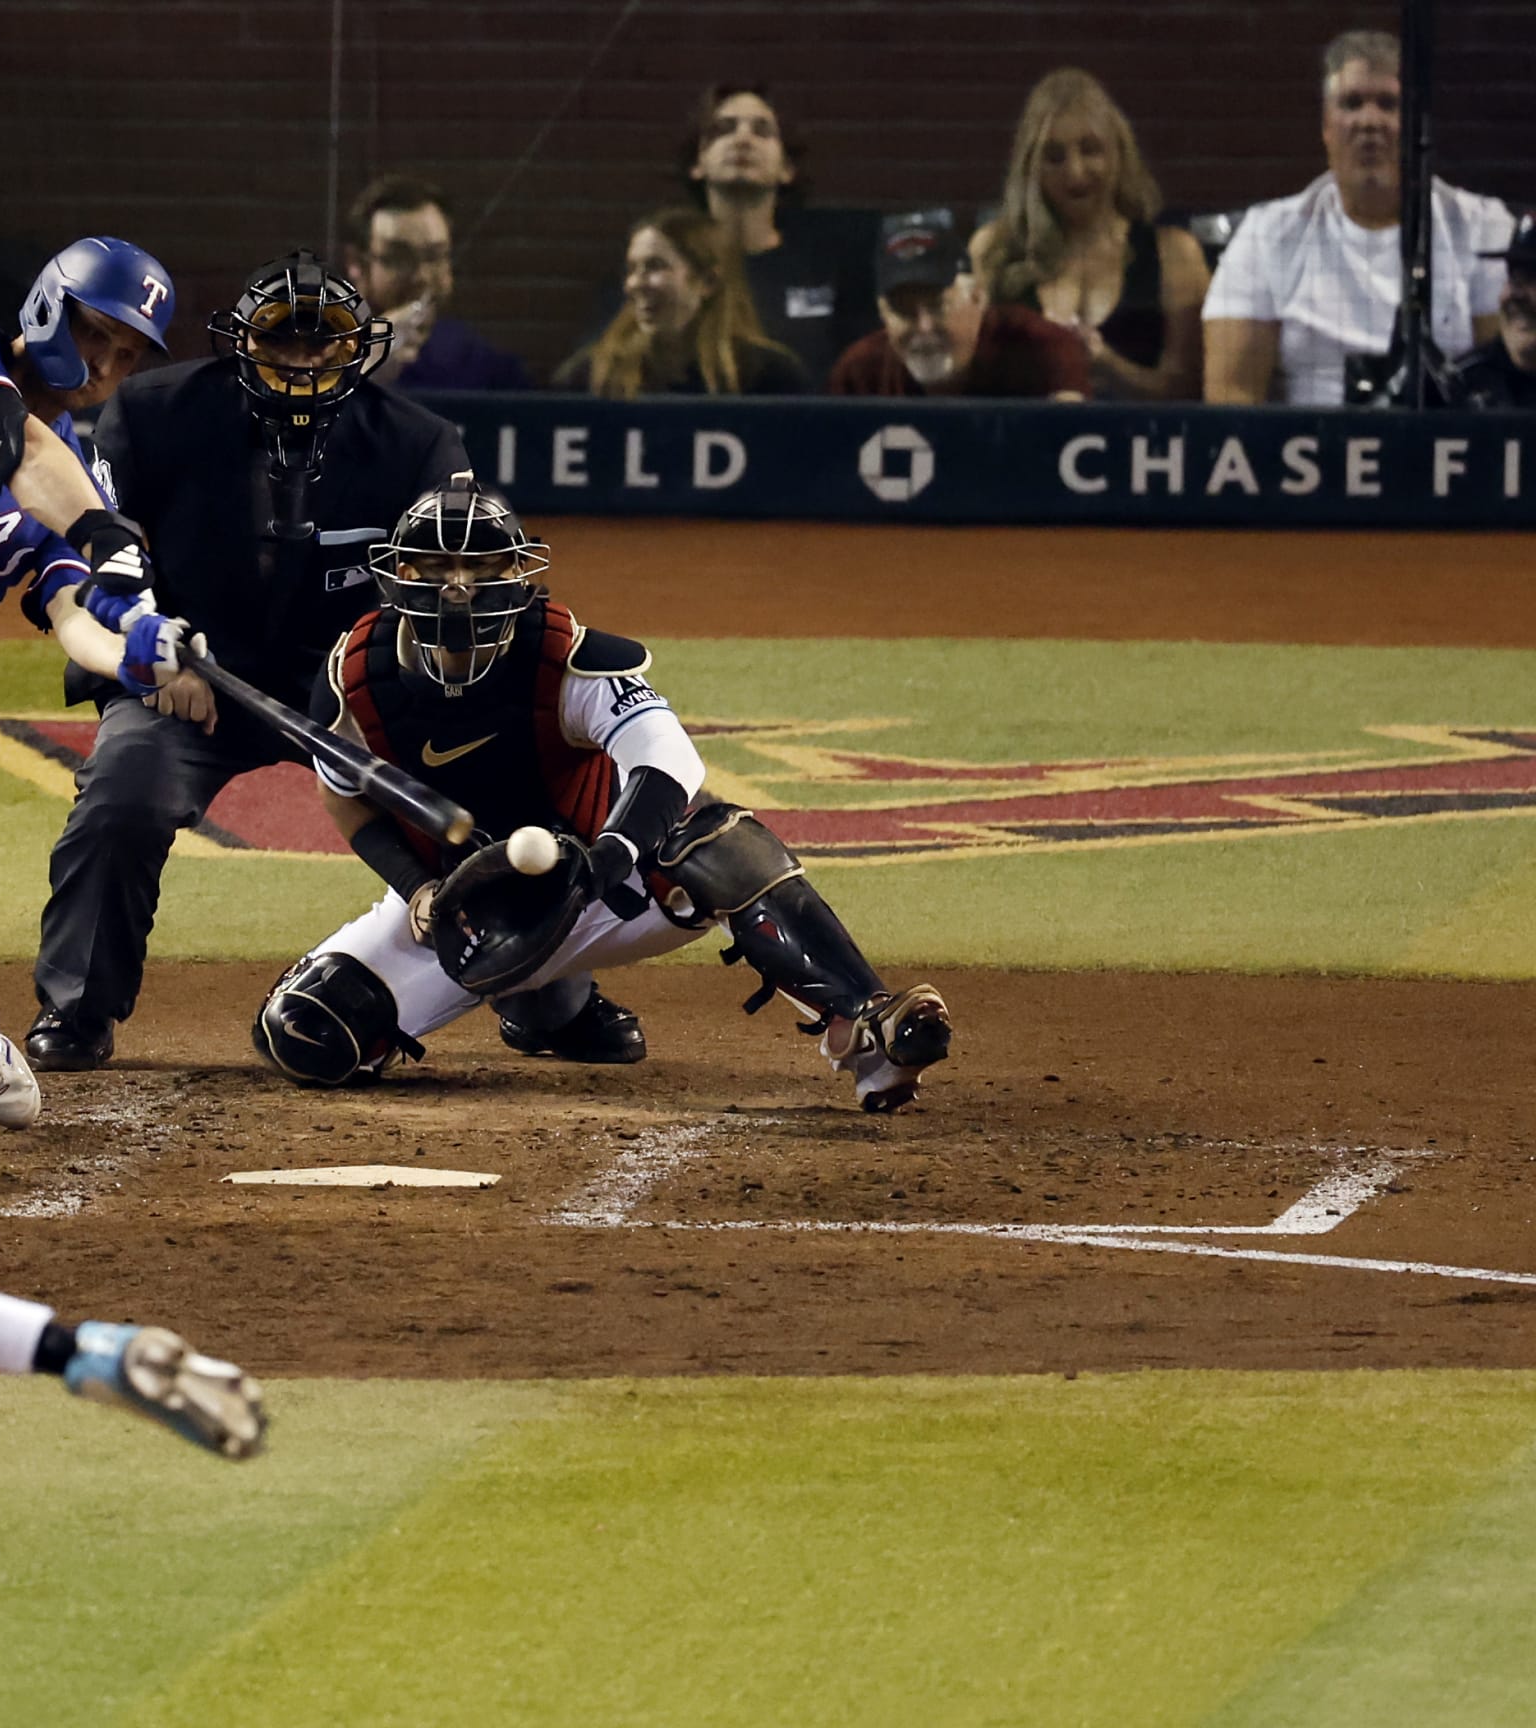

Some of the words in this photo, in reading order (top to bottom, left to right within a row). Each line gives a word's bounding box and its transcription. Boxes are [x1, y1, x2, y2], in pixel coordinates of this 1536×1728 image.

[139, 274, 169, 319] T
[457, 425, 749, 490] IELD
[1058, 434, 1382, 495] CHASE
[1433, 437, 1521, 497] FI
